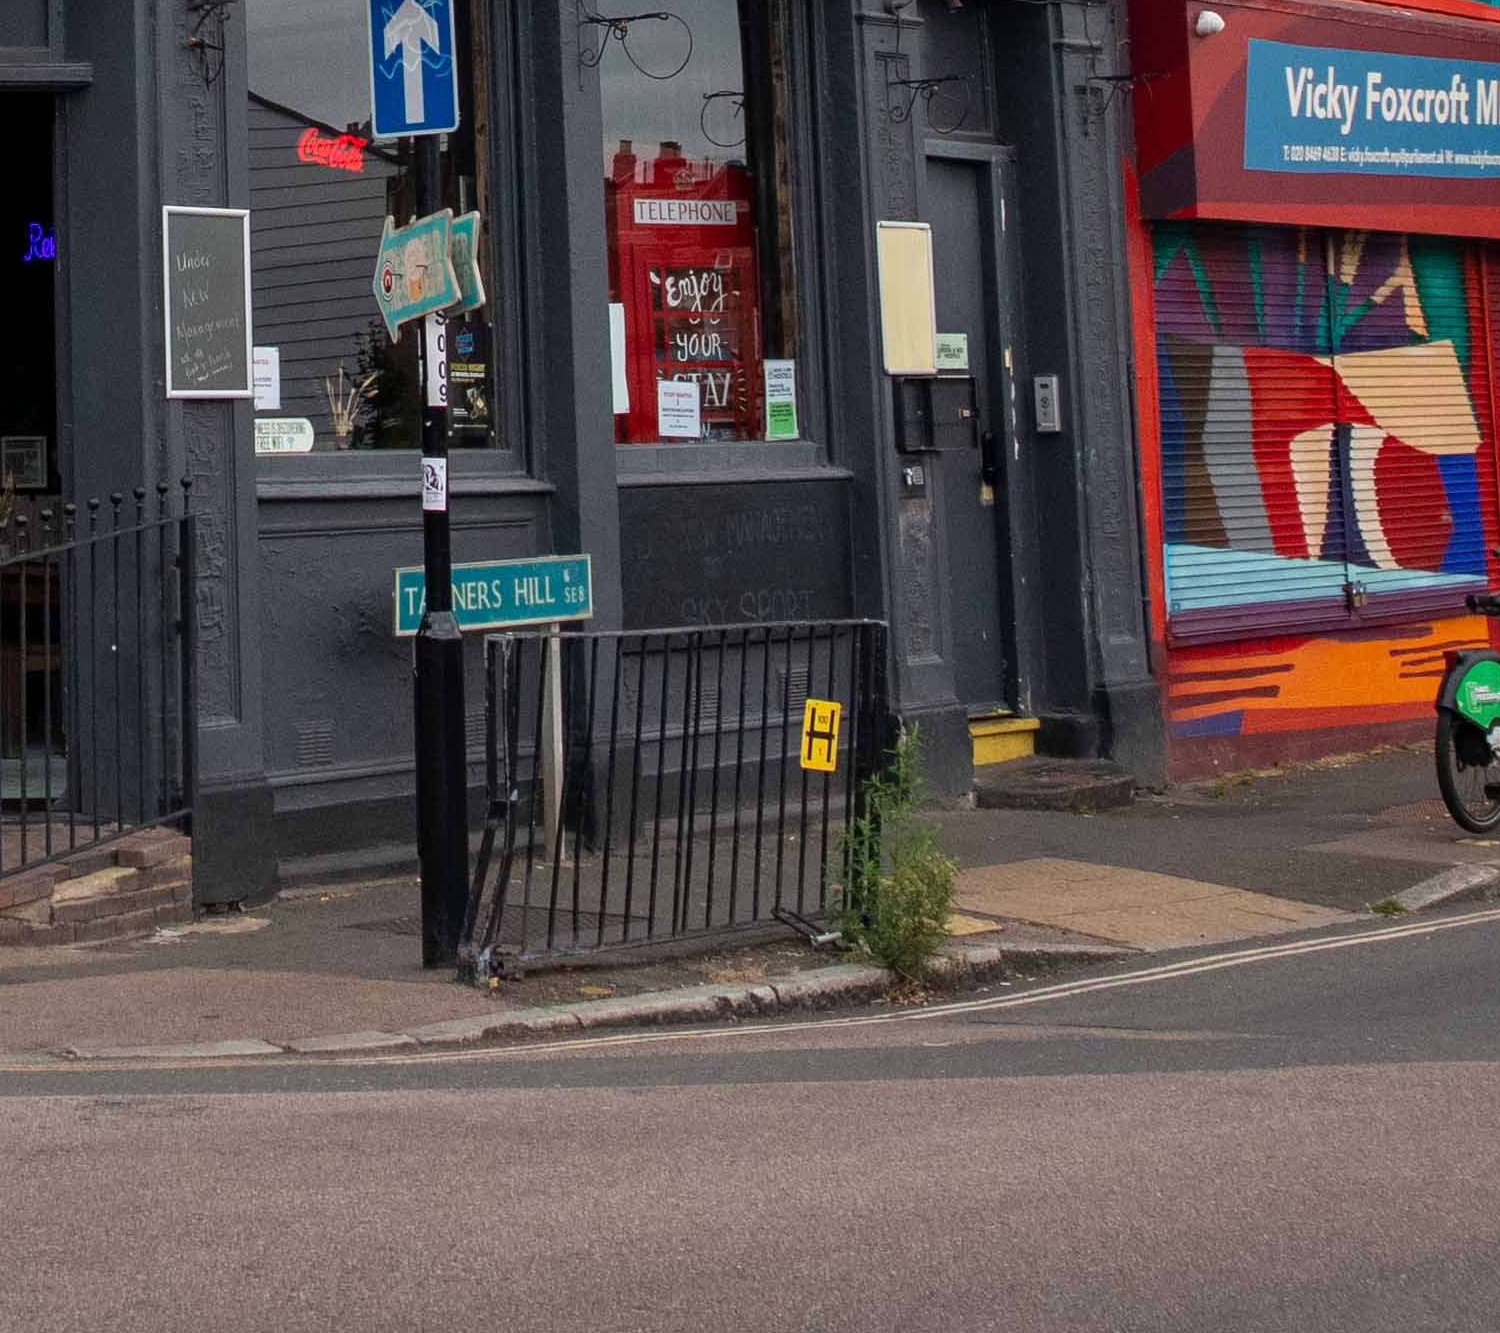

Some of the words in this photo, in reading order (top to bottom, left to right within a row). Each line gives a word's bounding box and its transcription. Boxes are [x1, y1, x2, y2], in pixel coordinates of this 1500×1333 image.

[1285, 65, 1359, 135] Vicky
[1365, 72, 1470, 125] Foxcroft
[637, 200, 734, 222] TELEPHONE
[664, 269, 728, 313] Enjoy
[404, 579, 502, 616] TANERS
[513, 576, 556, 607] HILL
[563, 585, 586, 604] SE8
